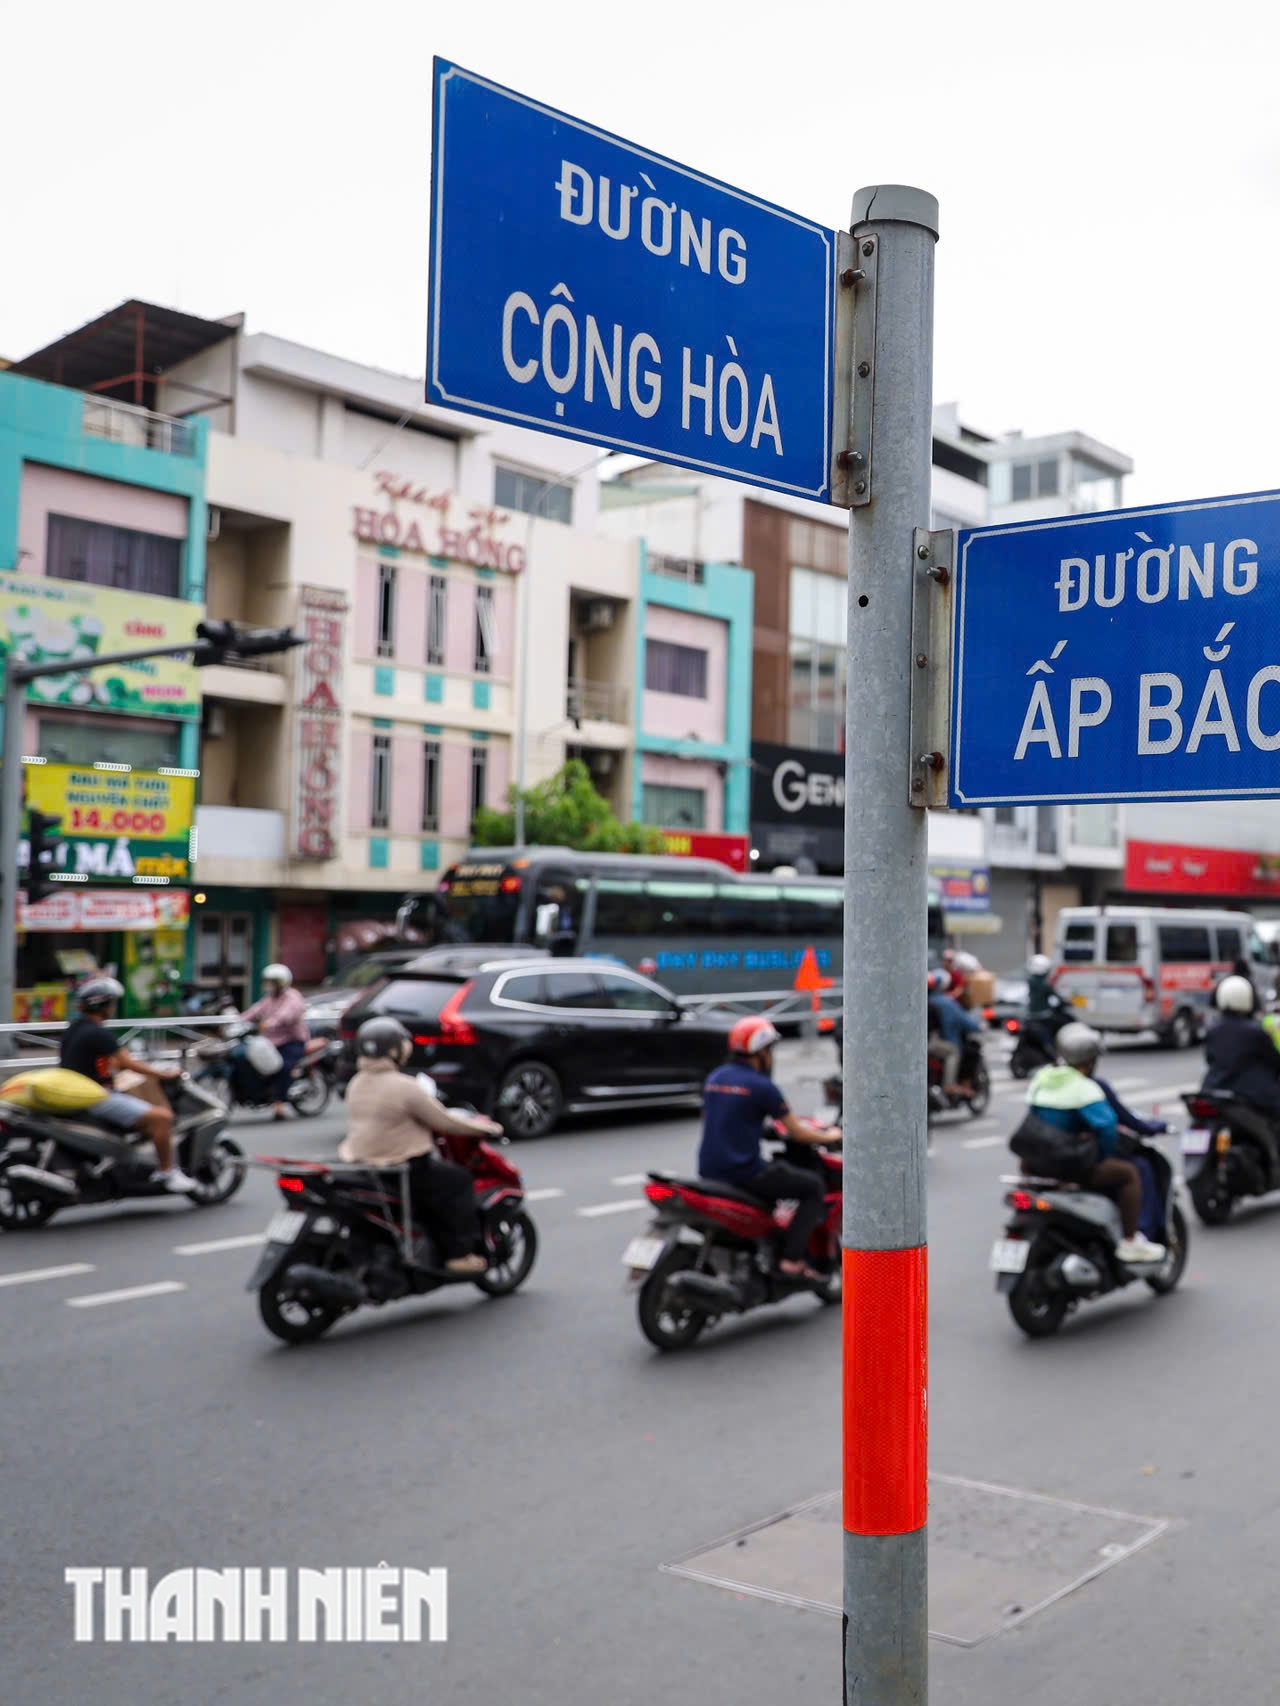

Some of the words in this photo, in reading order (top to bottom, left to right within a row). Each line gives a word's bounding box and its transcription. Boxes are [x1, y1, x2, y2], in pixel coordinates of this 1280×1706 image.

[555, 159, 747, 284] ĐƯỜNG
[502, 282, 661, 419] CỘNG
[682, 335, 783, 456] HÒA
[353, 506, 425, 554] HOA
[1054, 532, 1258, 612] ĐƯỜNG
[303, 616, 340, 708] HOA
[1013, 640, 1112, 760] ẤP
[71, 809, 167, 834] 14.000
